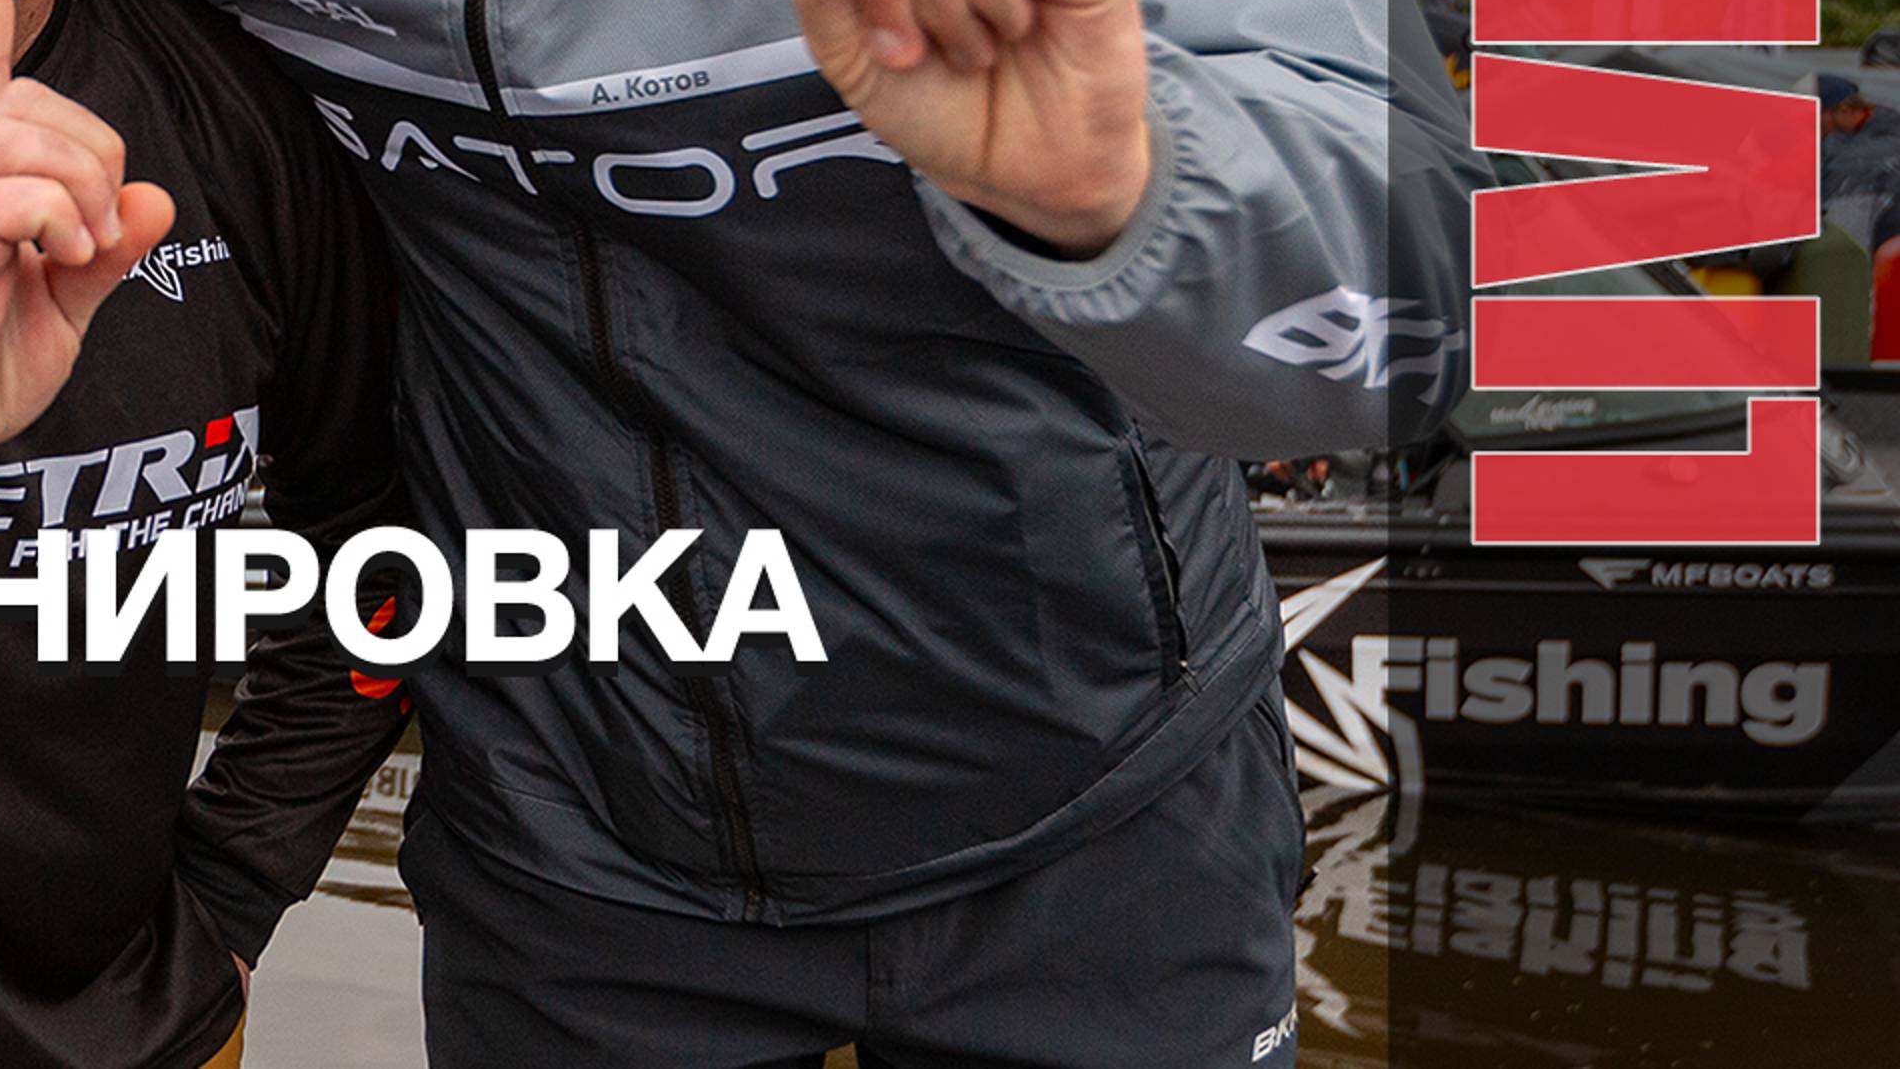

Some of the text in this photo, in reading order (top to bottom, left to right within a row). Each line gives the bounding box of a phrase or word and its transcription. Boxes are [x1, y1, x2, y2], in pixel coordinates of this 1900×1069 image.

[625, 70, 711, 100] Котов
[1652, 562, 1834, 588] MFBOATS
[1352, 635, 1831, 746] Fishing
